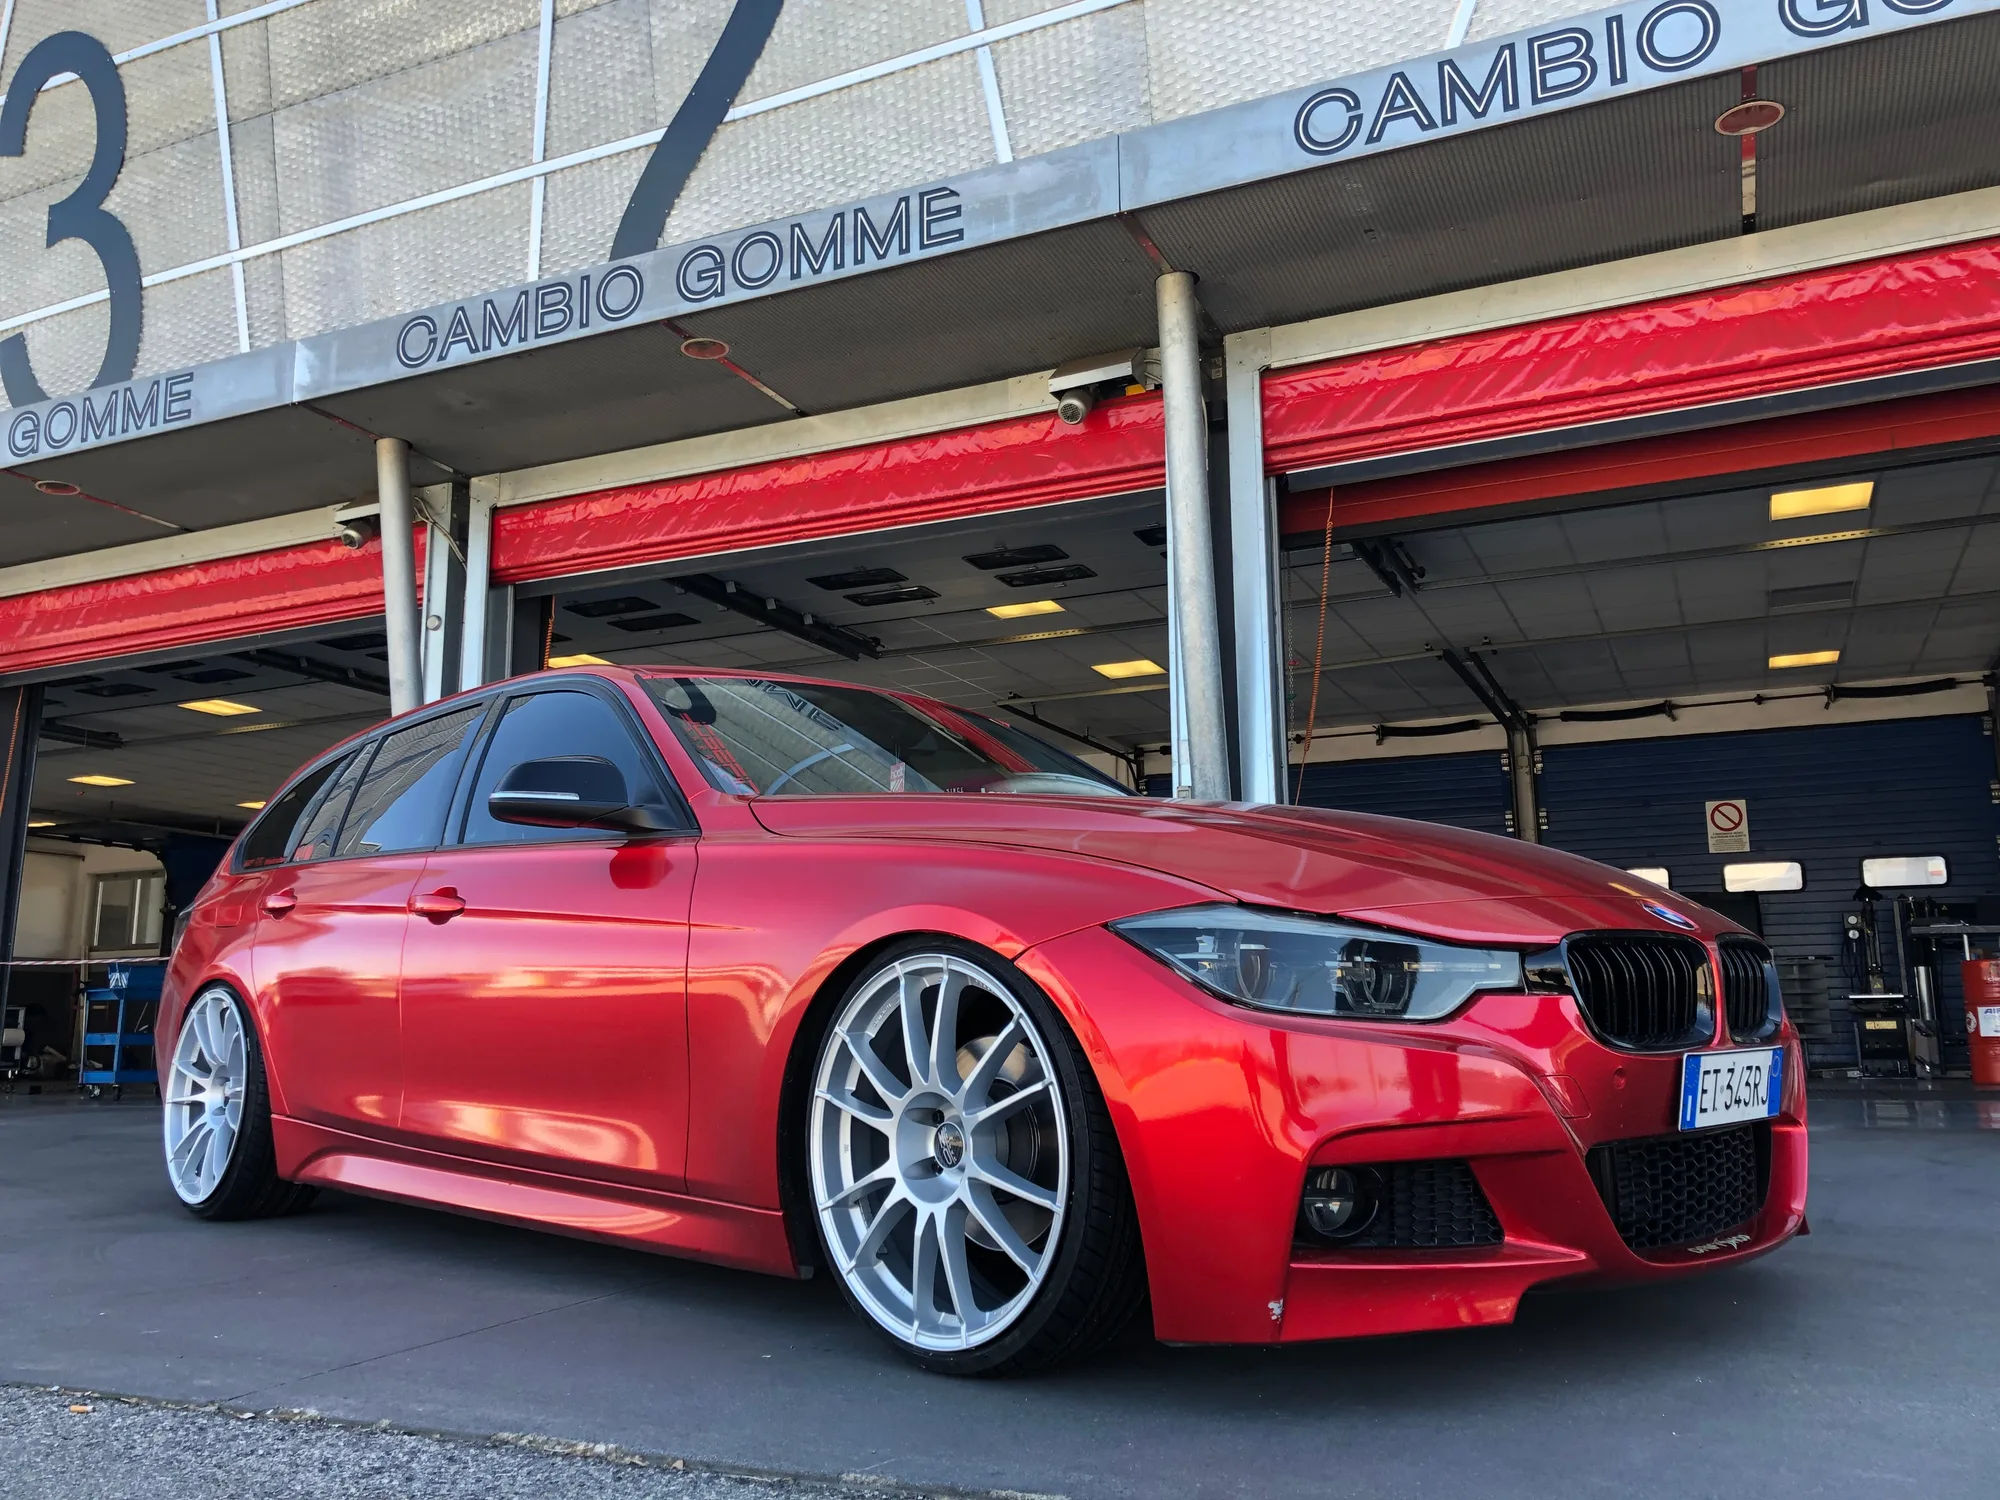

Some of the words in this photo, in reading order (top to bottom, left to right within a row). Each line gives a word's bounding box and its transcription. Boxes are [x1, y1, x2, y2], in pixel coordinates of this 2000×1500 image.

[1294, 0, 1721, 156] CAMBIO
[0, 31, 143, 405] 3
[396, 265, 644, 370] CAMBIO
[676, 187, 964, 303] GOMME
[7, 372, 195, 459] GOMME
